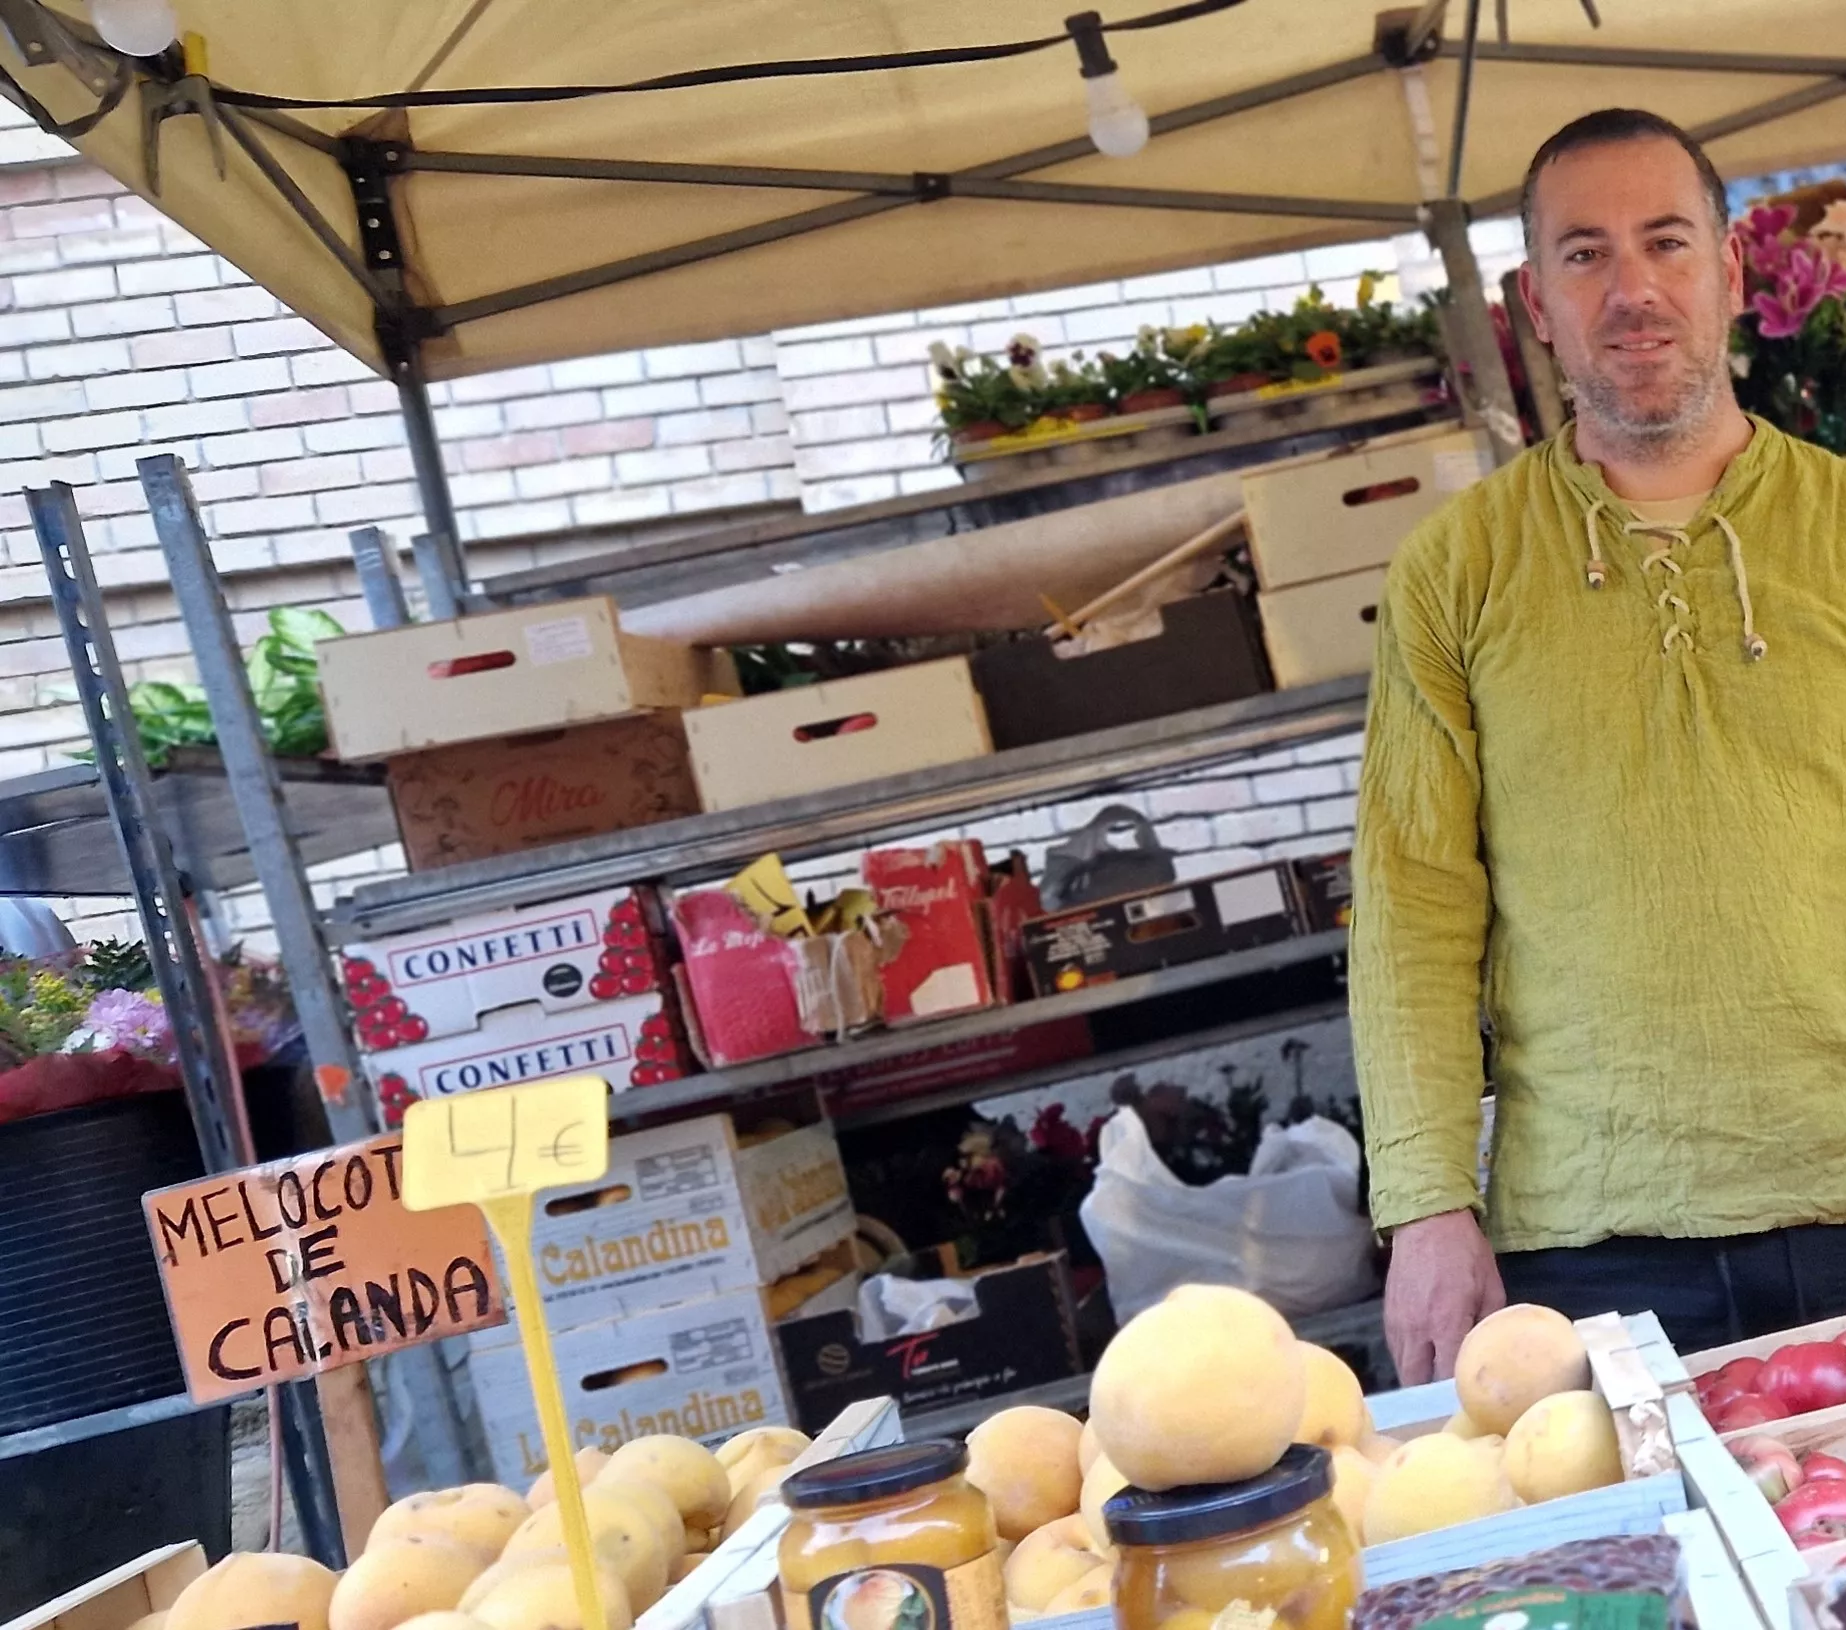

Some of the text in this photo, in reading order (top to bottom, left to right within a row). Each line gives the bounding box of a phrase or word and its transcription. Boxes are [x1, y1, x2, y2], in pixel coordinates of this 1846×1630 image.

[490, 776, 605, 827] Mira
[404, 920, 587, 980] CONFETTI
[436, 1034, 619, 1094] CONFETTI
[448, 1095, 516, 1189] 4
[155, 1144, 402, 1266] MELOCOT
[264, 1224, 346, 1295] DE
[540, 1216, 730, 1286] Calandina
[208, 1255, 490, 1381] CALANDA
[575, 1388, 765, 1455] Calandina
